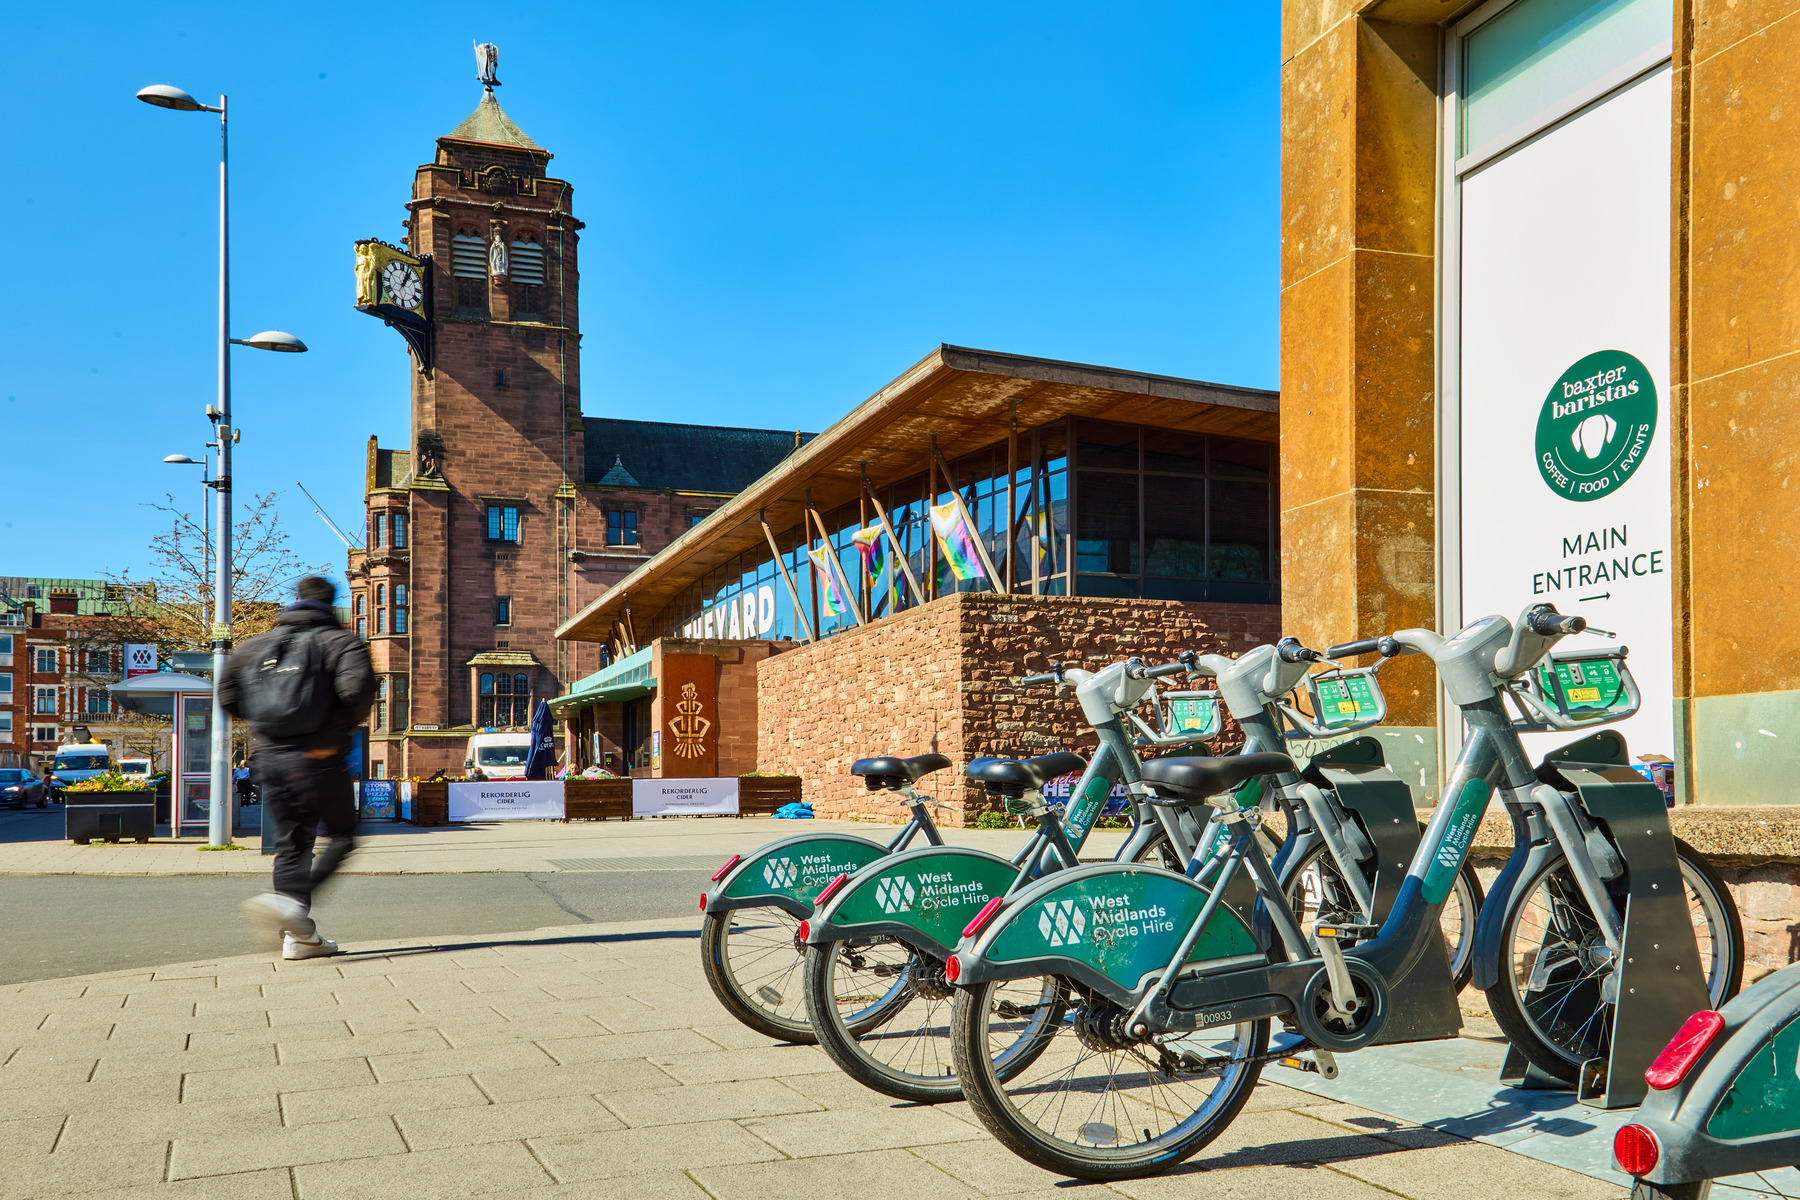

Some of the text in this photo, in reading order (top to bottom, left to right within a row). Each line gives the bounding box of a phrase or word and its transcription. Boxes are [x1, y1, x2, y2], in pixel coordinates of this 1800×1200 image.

[1562, 365, 1627, 399] baxter
[1551, 379, 1640, 420] baristas
[1542, 423, 1650, 494] COFFEE FOOD EVENTS
[1563, 524, 1628, 559] MAIN
[1533, 550, 1664, 595] ENTRANCE
[481, 791, 531, 799] REKORDERLIG
[1043, 783, 1070, 797] HE
[1072, 808, 1083, 822] West
[1078, 801, 1094, 824] Midlands
[1445, 824, 1458, 843] West
[1452, 813, 1470, 847] Midlands
[1458, 814, 1477, 849] Cycle Hire
[800, 854, 831, 865] West
[802, 861, 858, 875] Midlands
[802, 874, 836, 886] Cycle
[917, 871, 953, 885] West
[920, 880, 983, 897] Midlands
[921, 892, 990, 910] Cycle Hire
[1088, 893, 1131, 910] West
[1092, 904, 1167, 926] Midlands
[1093, 919, 1174, 941] Cycle Hire
[1203, 1010, 1232, 1024] 00933
